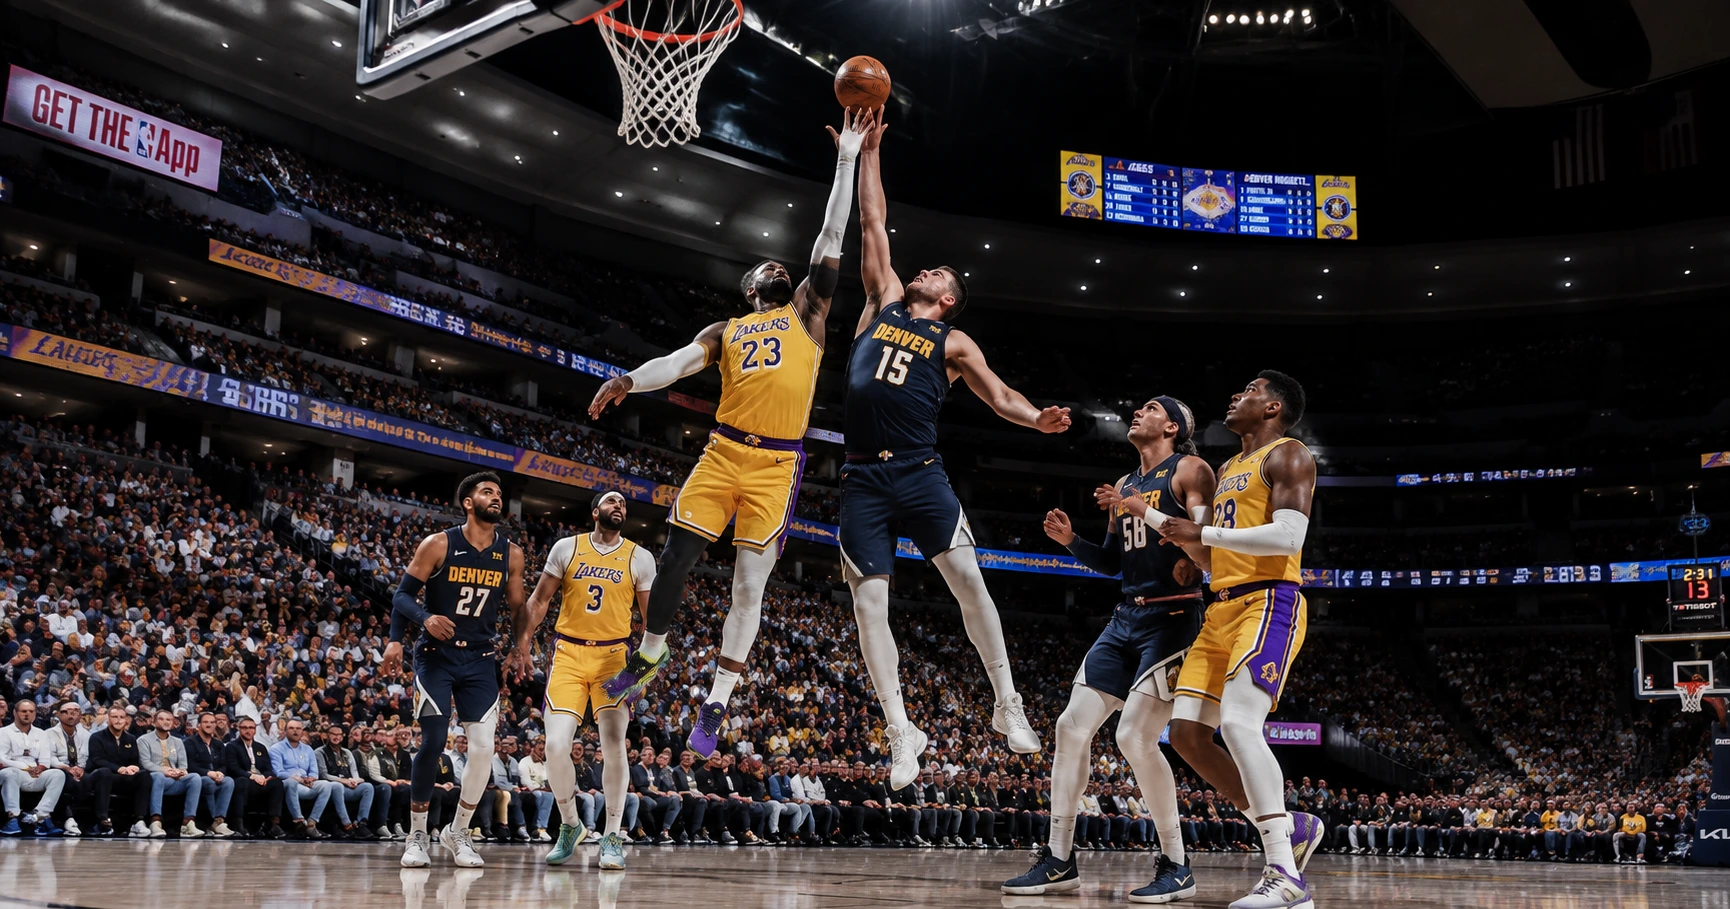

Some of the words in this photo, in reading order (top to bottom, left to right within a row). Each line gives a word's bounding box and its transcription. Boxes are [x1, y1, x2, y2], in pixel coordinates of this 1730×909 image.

[32, 84, 82, 134] GET
[89, 103, 133, 152] THE
[155, 128, 200, 177] App
[730, 316, 791, 345] LAKERS
[872, 322, 936, 359] DENVER
[741, 336, 782, 373] 23
[874, 345, 914, 386] 15
[448, 566, 502, 588] DENVER
[572, 562, 623, 584] LAKERS
[455, 586, 490, 618] 27
[585, 584, 604, 615] 3
[1688, 580, 1709, 599] 13
